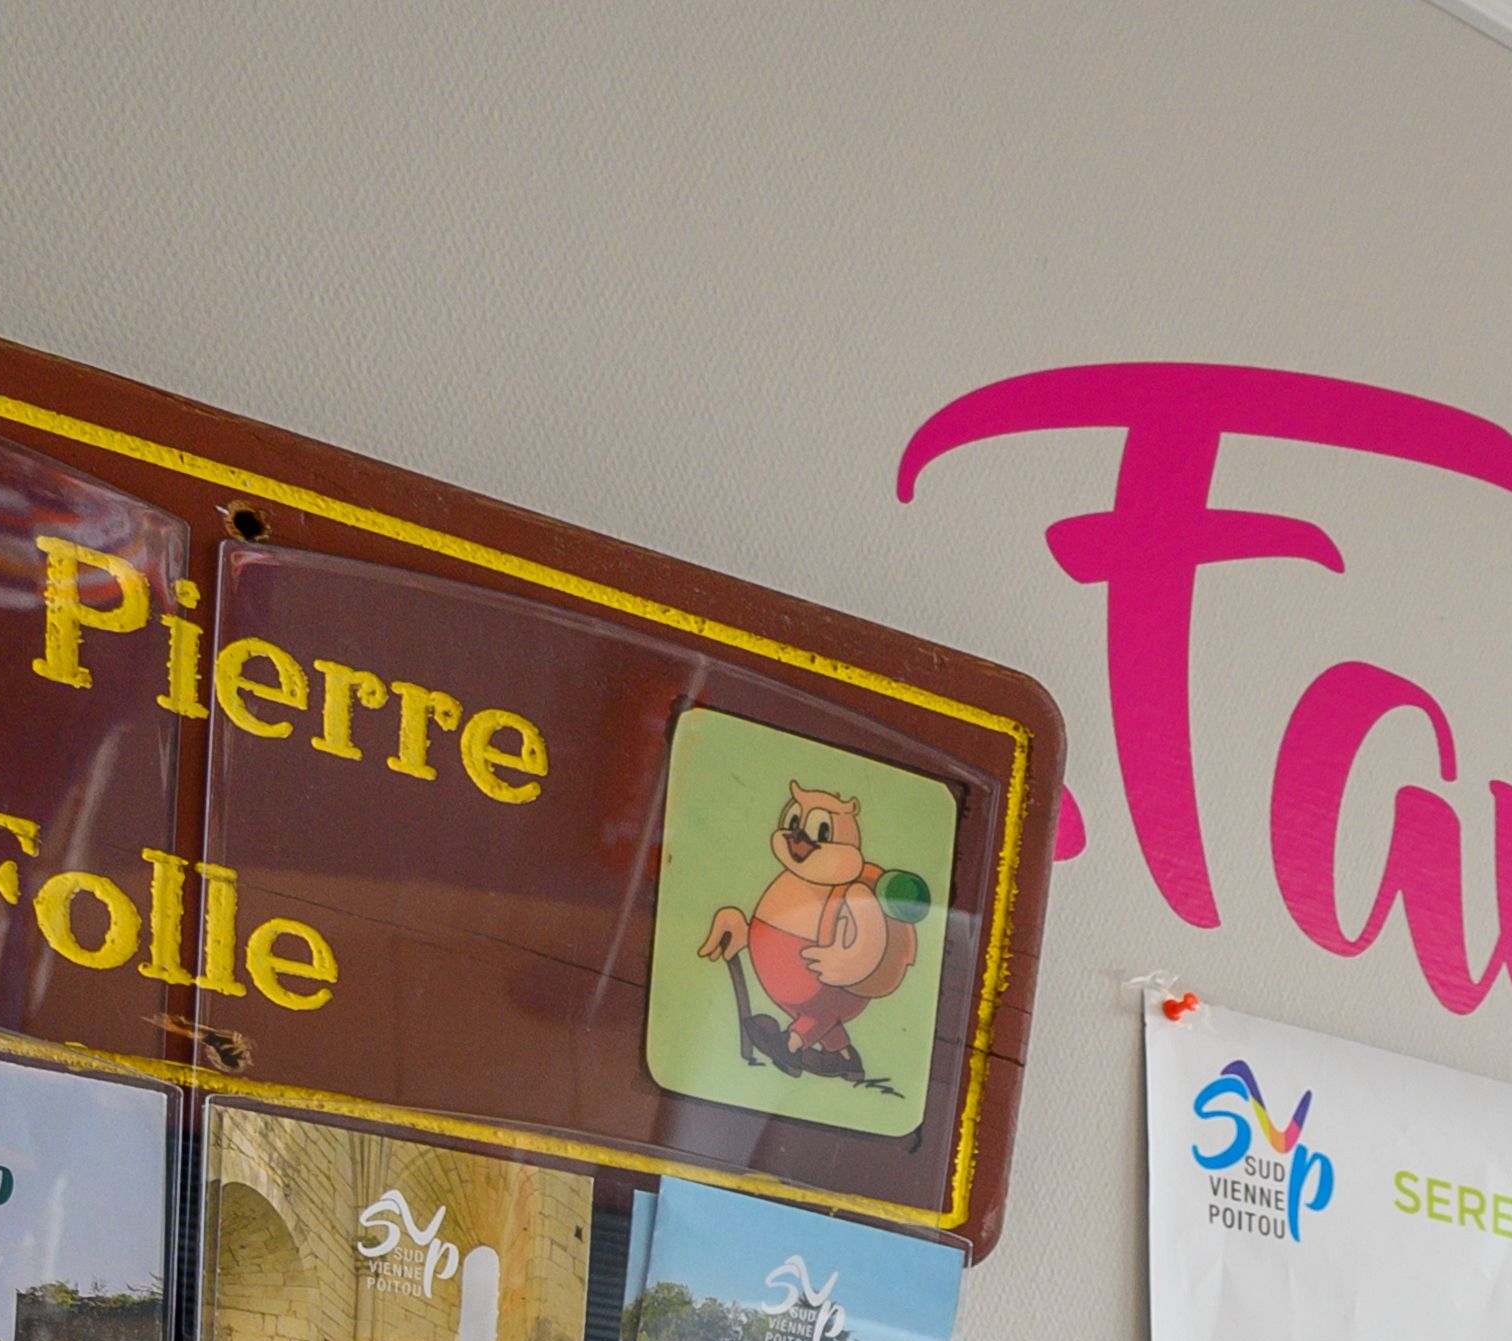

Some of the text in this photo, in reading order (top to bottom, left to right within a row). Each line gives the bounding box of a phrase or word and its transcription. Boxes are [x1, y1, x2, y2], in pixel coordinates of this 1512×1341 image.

[33, 534, 549, 805] Pierre
[1245, 1155, 1287, 1184] SUD
[1209, 1174, 1287, 1212] VIENNE
[1207, 1204, 1288, 1241] POITOU
